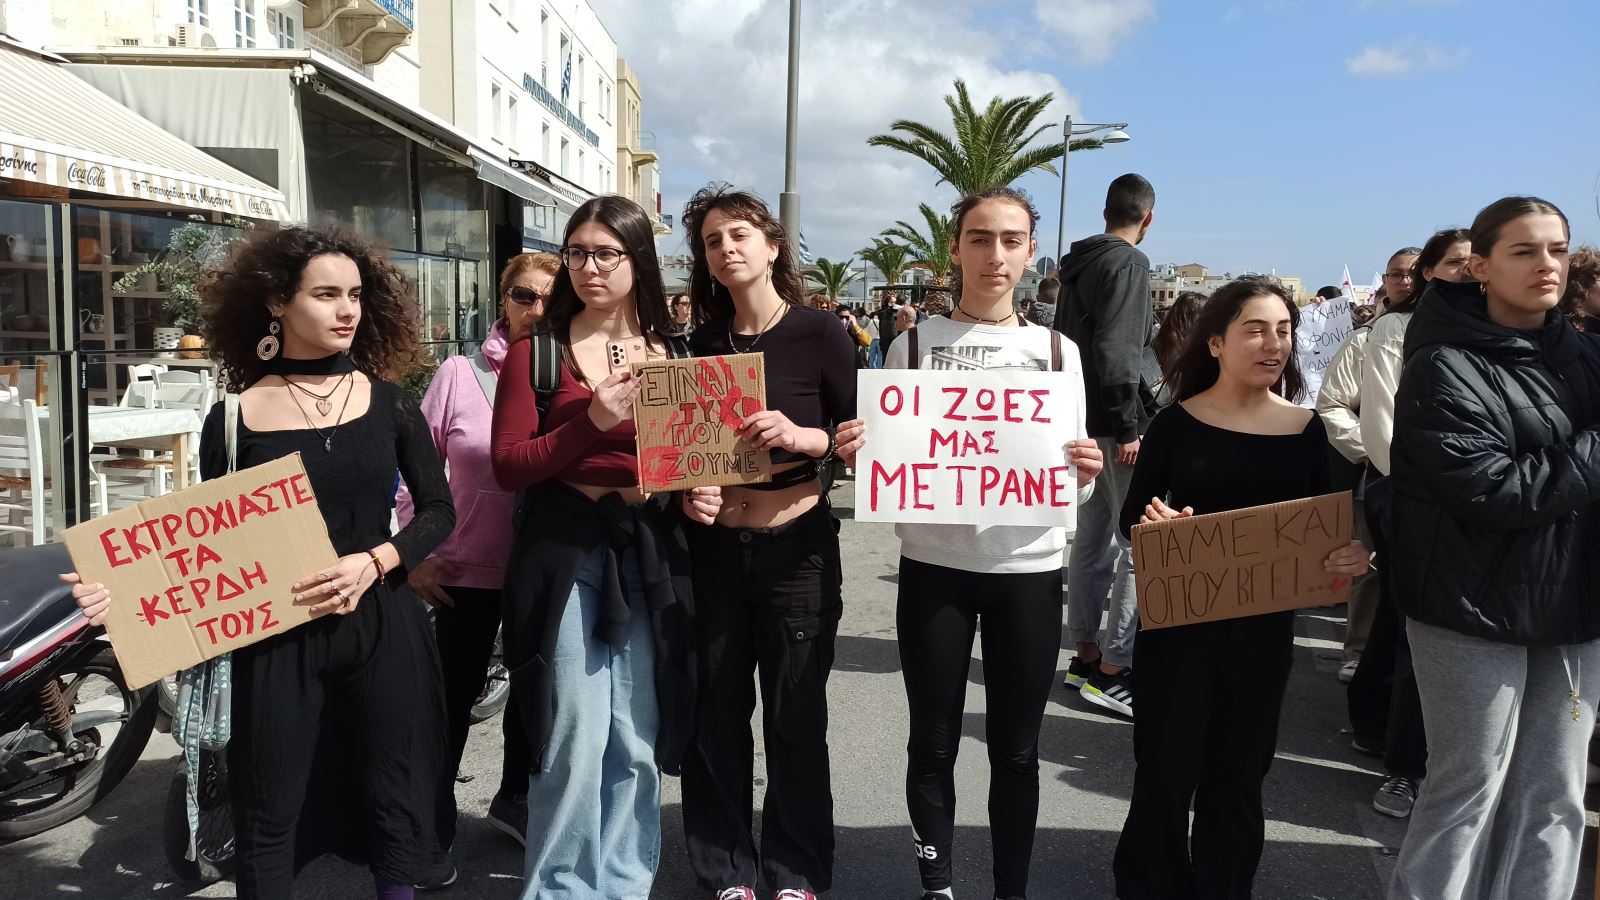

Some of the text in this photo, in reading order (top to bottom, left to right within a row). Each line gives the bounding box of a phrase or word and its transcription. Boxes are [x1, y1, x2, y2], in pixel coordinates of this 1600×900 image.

[1298, 300, 1350, 324] ΤΥΧΗΜΑ
[640, 363, 735, 407] ΕΙΝΑΙ
[879, 384, 1052, 424] ΟΙ ΖΩΕΣ
[671, 421, 724, 447] ΠΟΥ
[928, 428, 1000, 459] ΜΑΣ
[662, 450, 759, 482] ΖΟΥΜΕ
[99, 472, 316, 569] ΕΚΤΡΟΧΙΑΣΤΕ
[1139, 501, 1341, 572] ΠΑΜΕ ΚΑΙ
[163, 542, 223, 578] ΤΑ
[137, 560, 269, 627] ΚΕΡΔΗ
[1144, 566, 1229, 625] ΟΠΟΥ
[194, 600, 281, 645] ΤΟΥΣ
